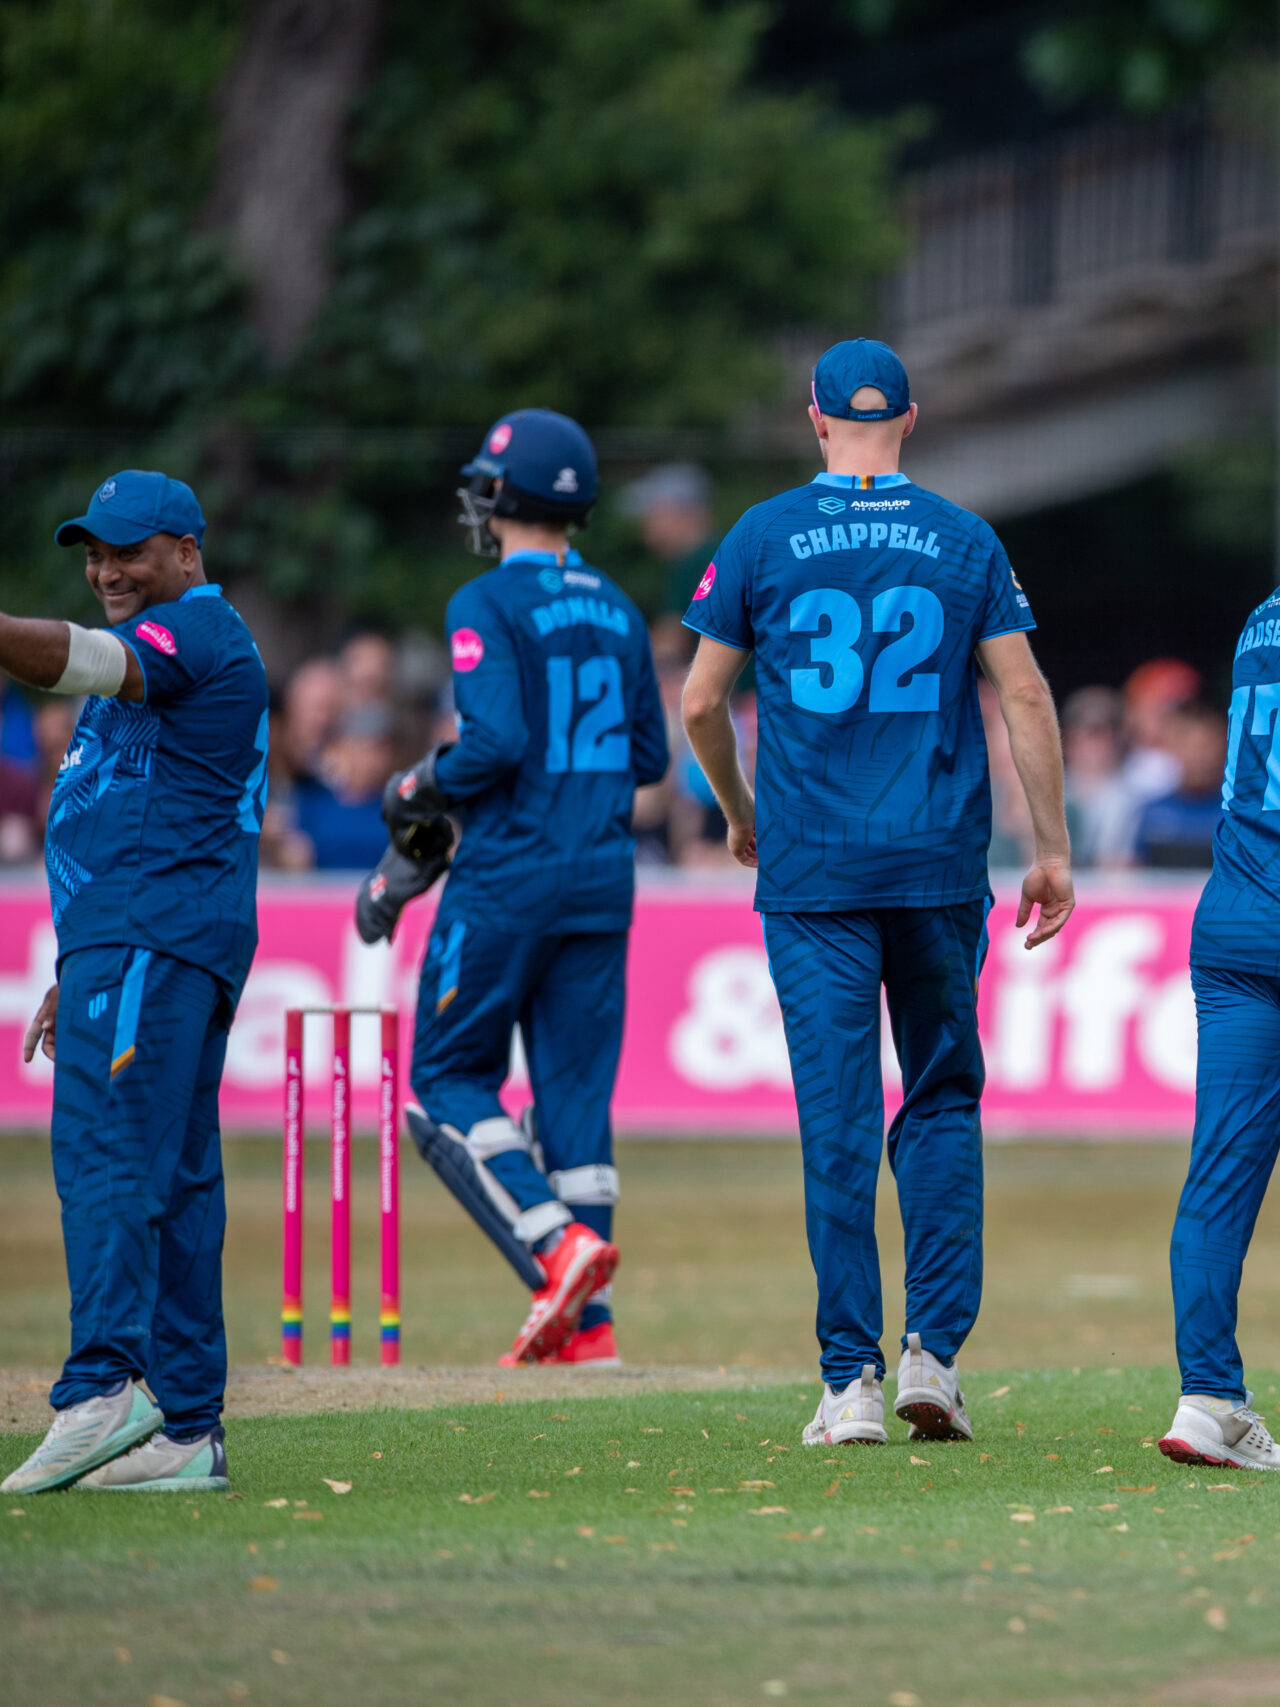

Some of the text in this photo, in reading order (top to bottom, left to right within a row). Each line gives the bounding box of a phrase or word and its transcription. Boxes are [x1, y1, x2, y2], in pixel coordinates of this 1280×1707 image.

[789, 522, 941, 560] CHAPPELL
[789, 585, 945, 714] 32
[545, 655, 631, 773] 12
[882, 912, 1198, 1095] if
